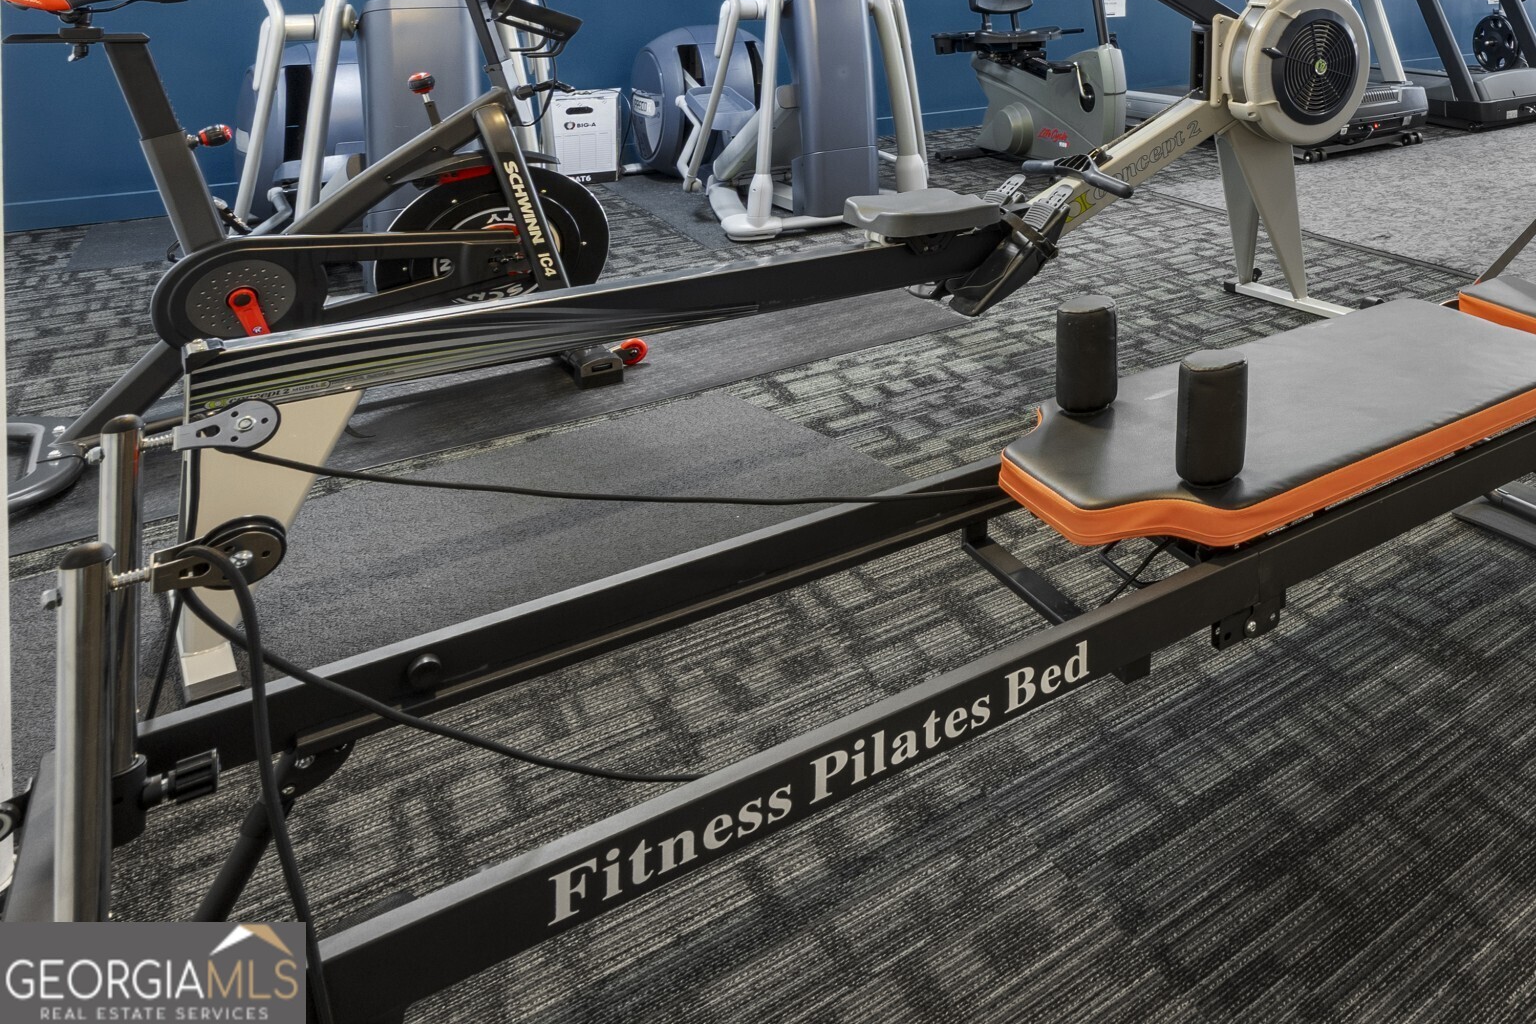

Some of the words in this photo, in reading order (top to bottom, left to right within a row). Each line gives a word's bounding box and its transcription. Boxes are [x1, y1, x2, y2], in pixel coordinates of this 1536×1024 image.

[1187, 120, 1202, 139] 2
[569, 175, 592, 183] AT6
[503, 160, 545, 246] SCHWINN
[537, 252, 557, 277] IC4
[292, 384, 319, 392] MODEL
[547, 783, 793, 927] Fitness
[809, 693, 991, 805] Pilates
[1003, 639, 1091, 716] Bed
